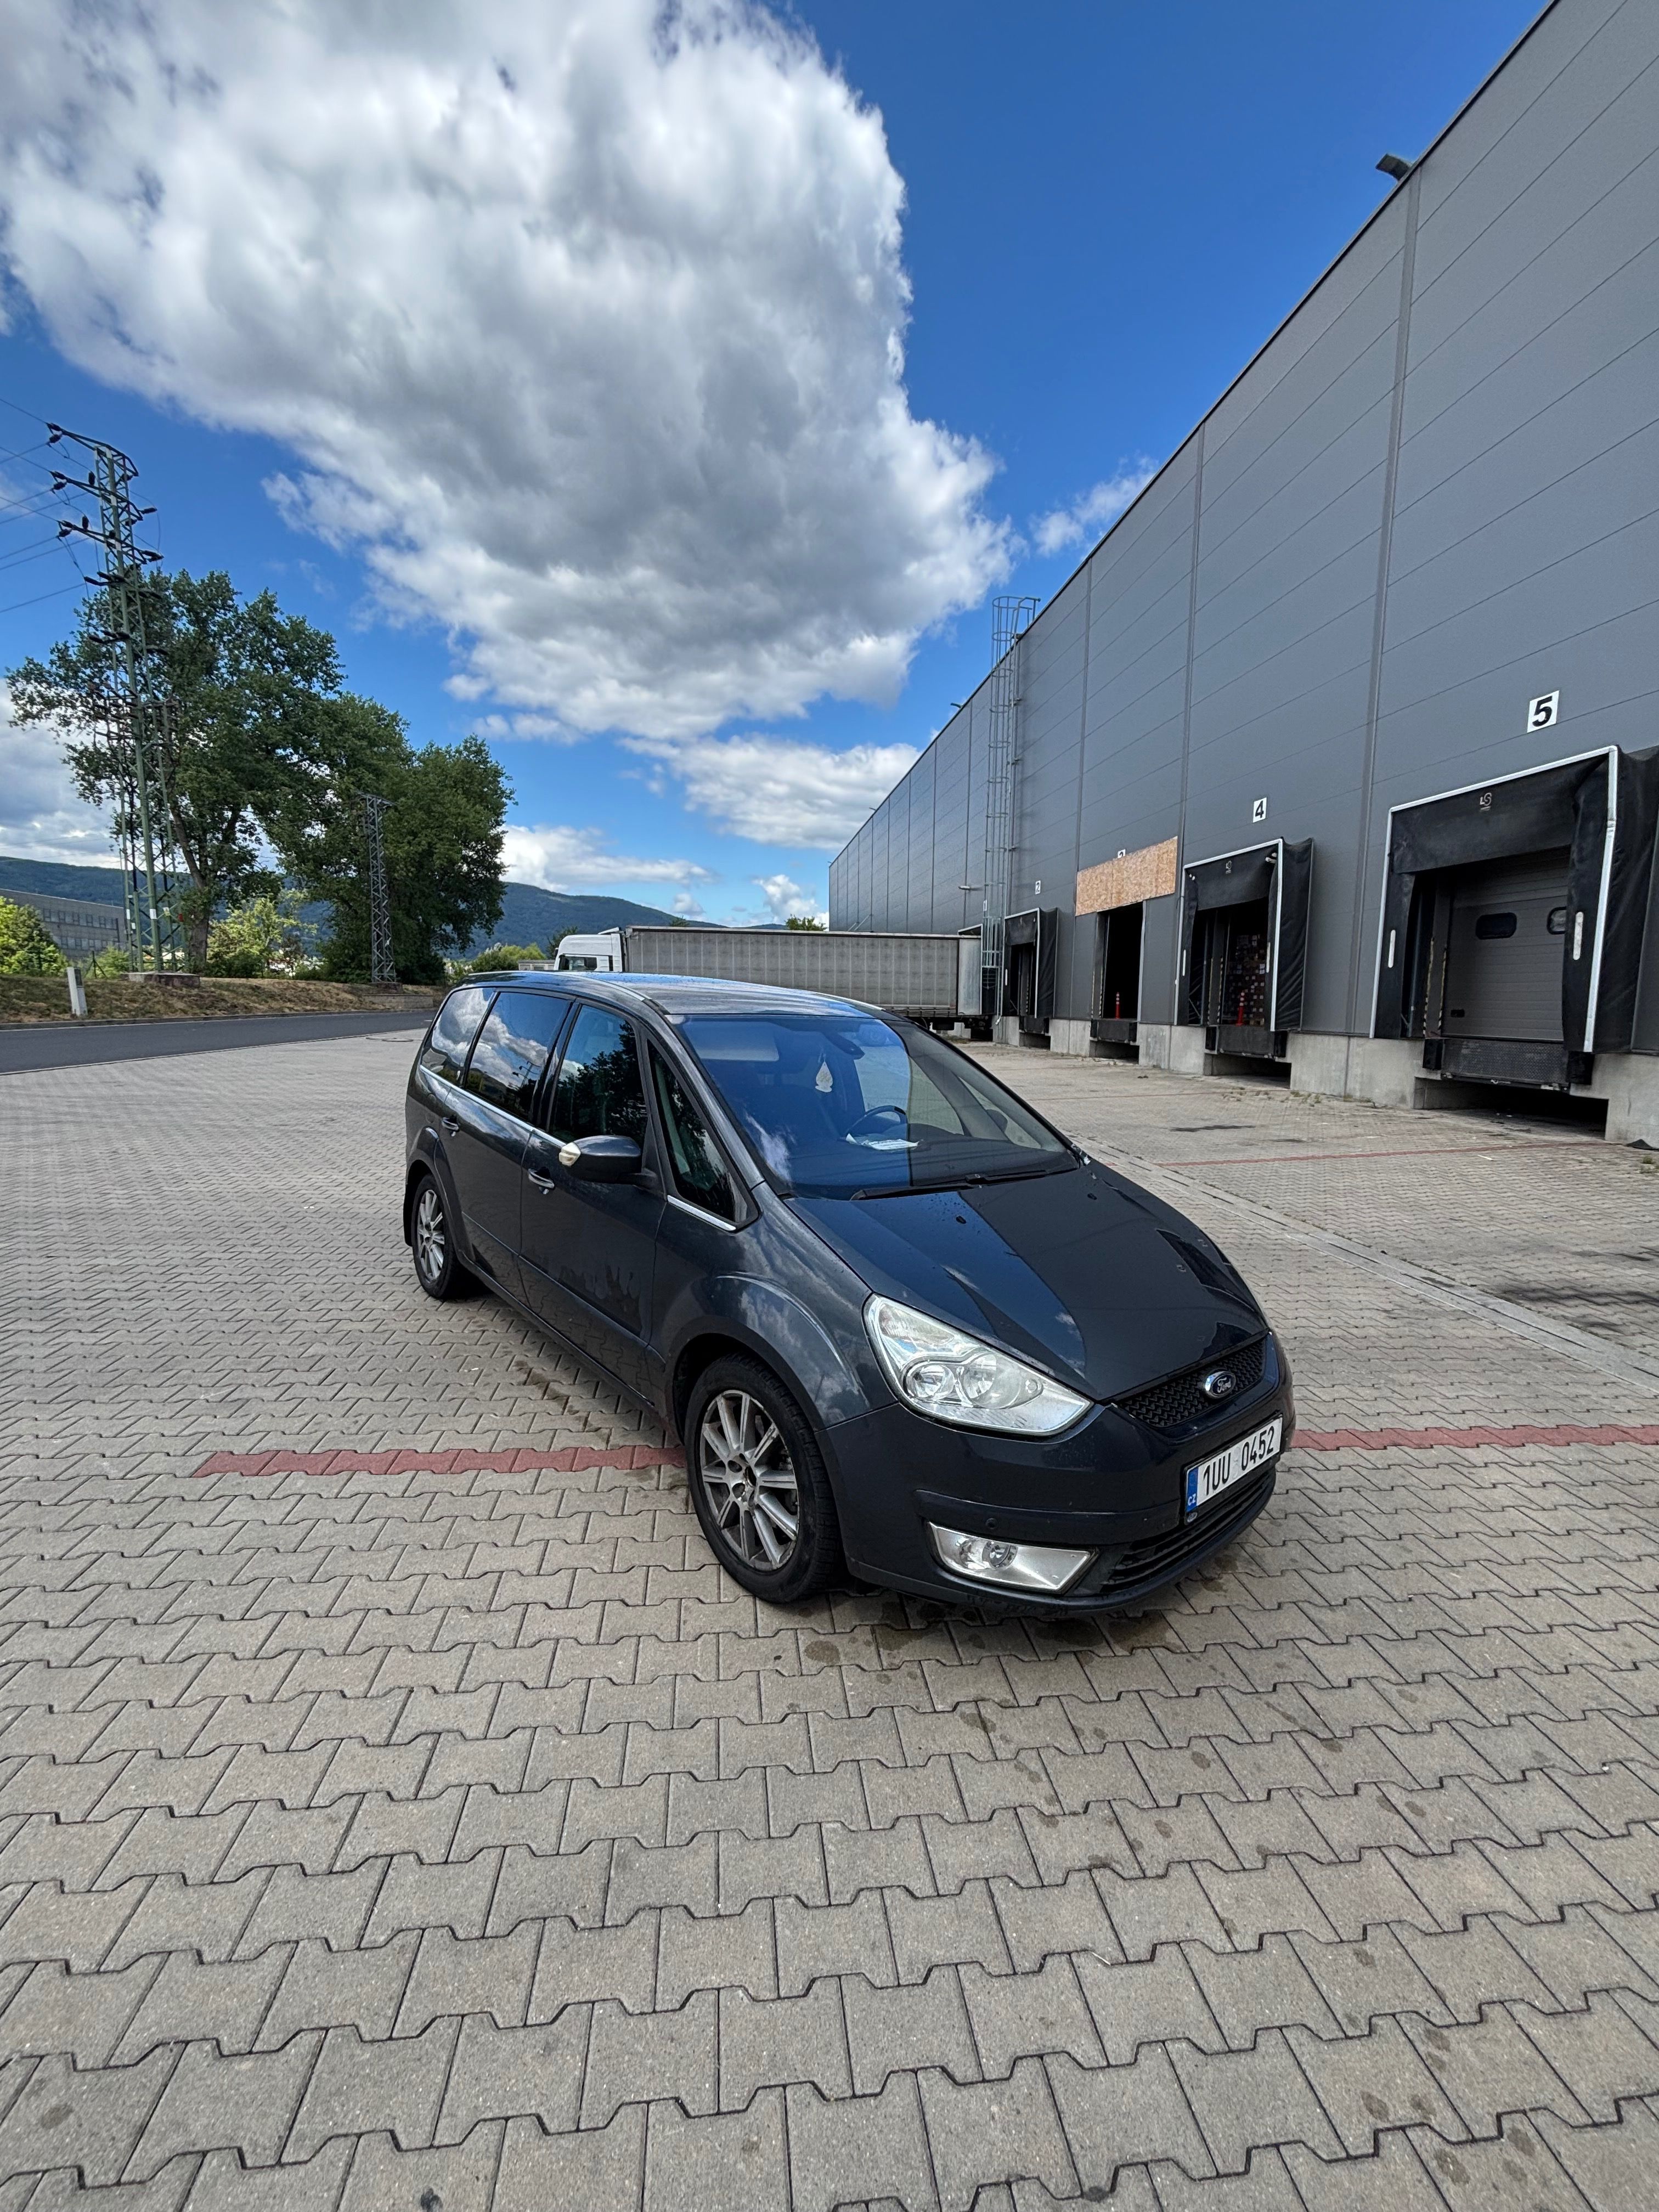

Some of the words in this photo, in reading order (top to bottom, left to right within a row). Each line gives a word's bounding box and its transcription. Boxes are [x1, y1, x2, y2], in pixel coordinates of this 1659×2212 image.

[1532, 695, 1553, 727] 5
[1255, 800, 1264, 818] 4
[1036, 882, 1040, 893] 2
[1217, 1377, 1231, 1393] Ford
[1203, 1452, 1231, 1496] 1UU
[1242, 1426, 1274, 1471] 0452
[1188, 1493, 1196, 1506] CZ
